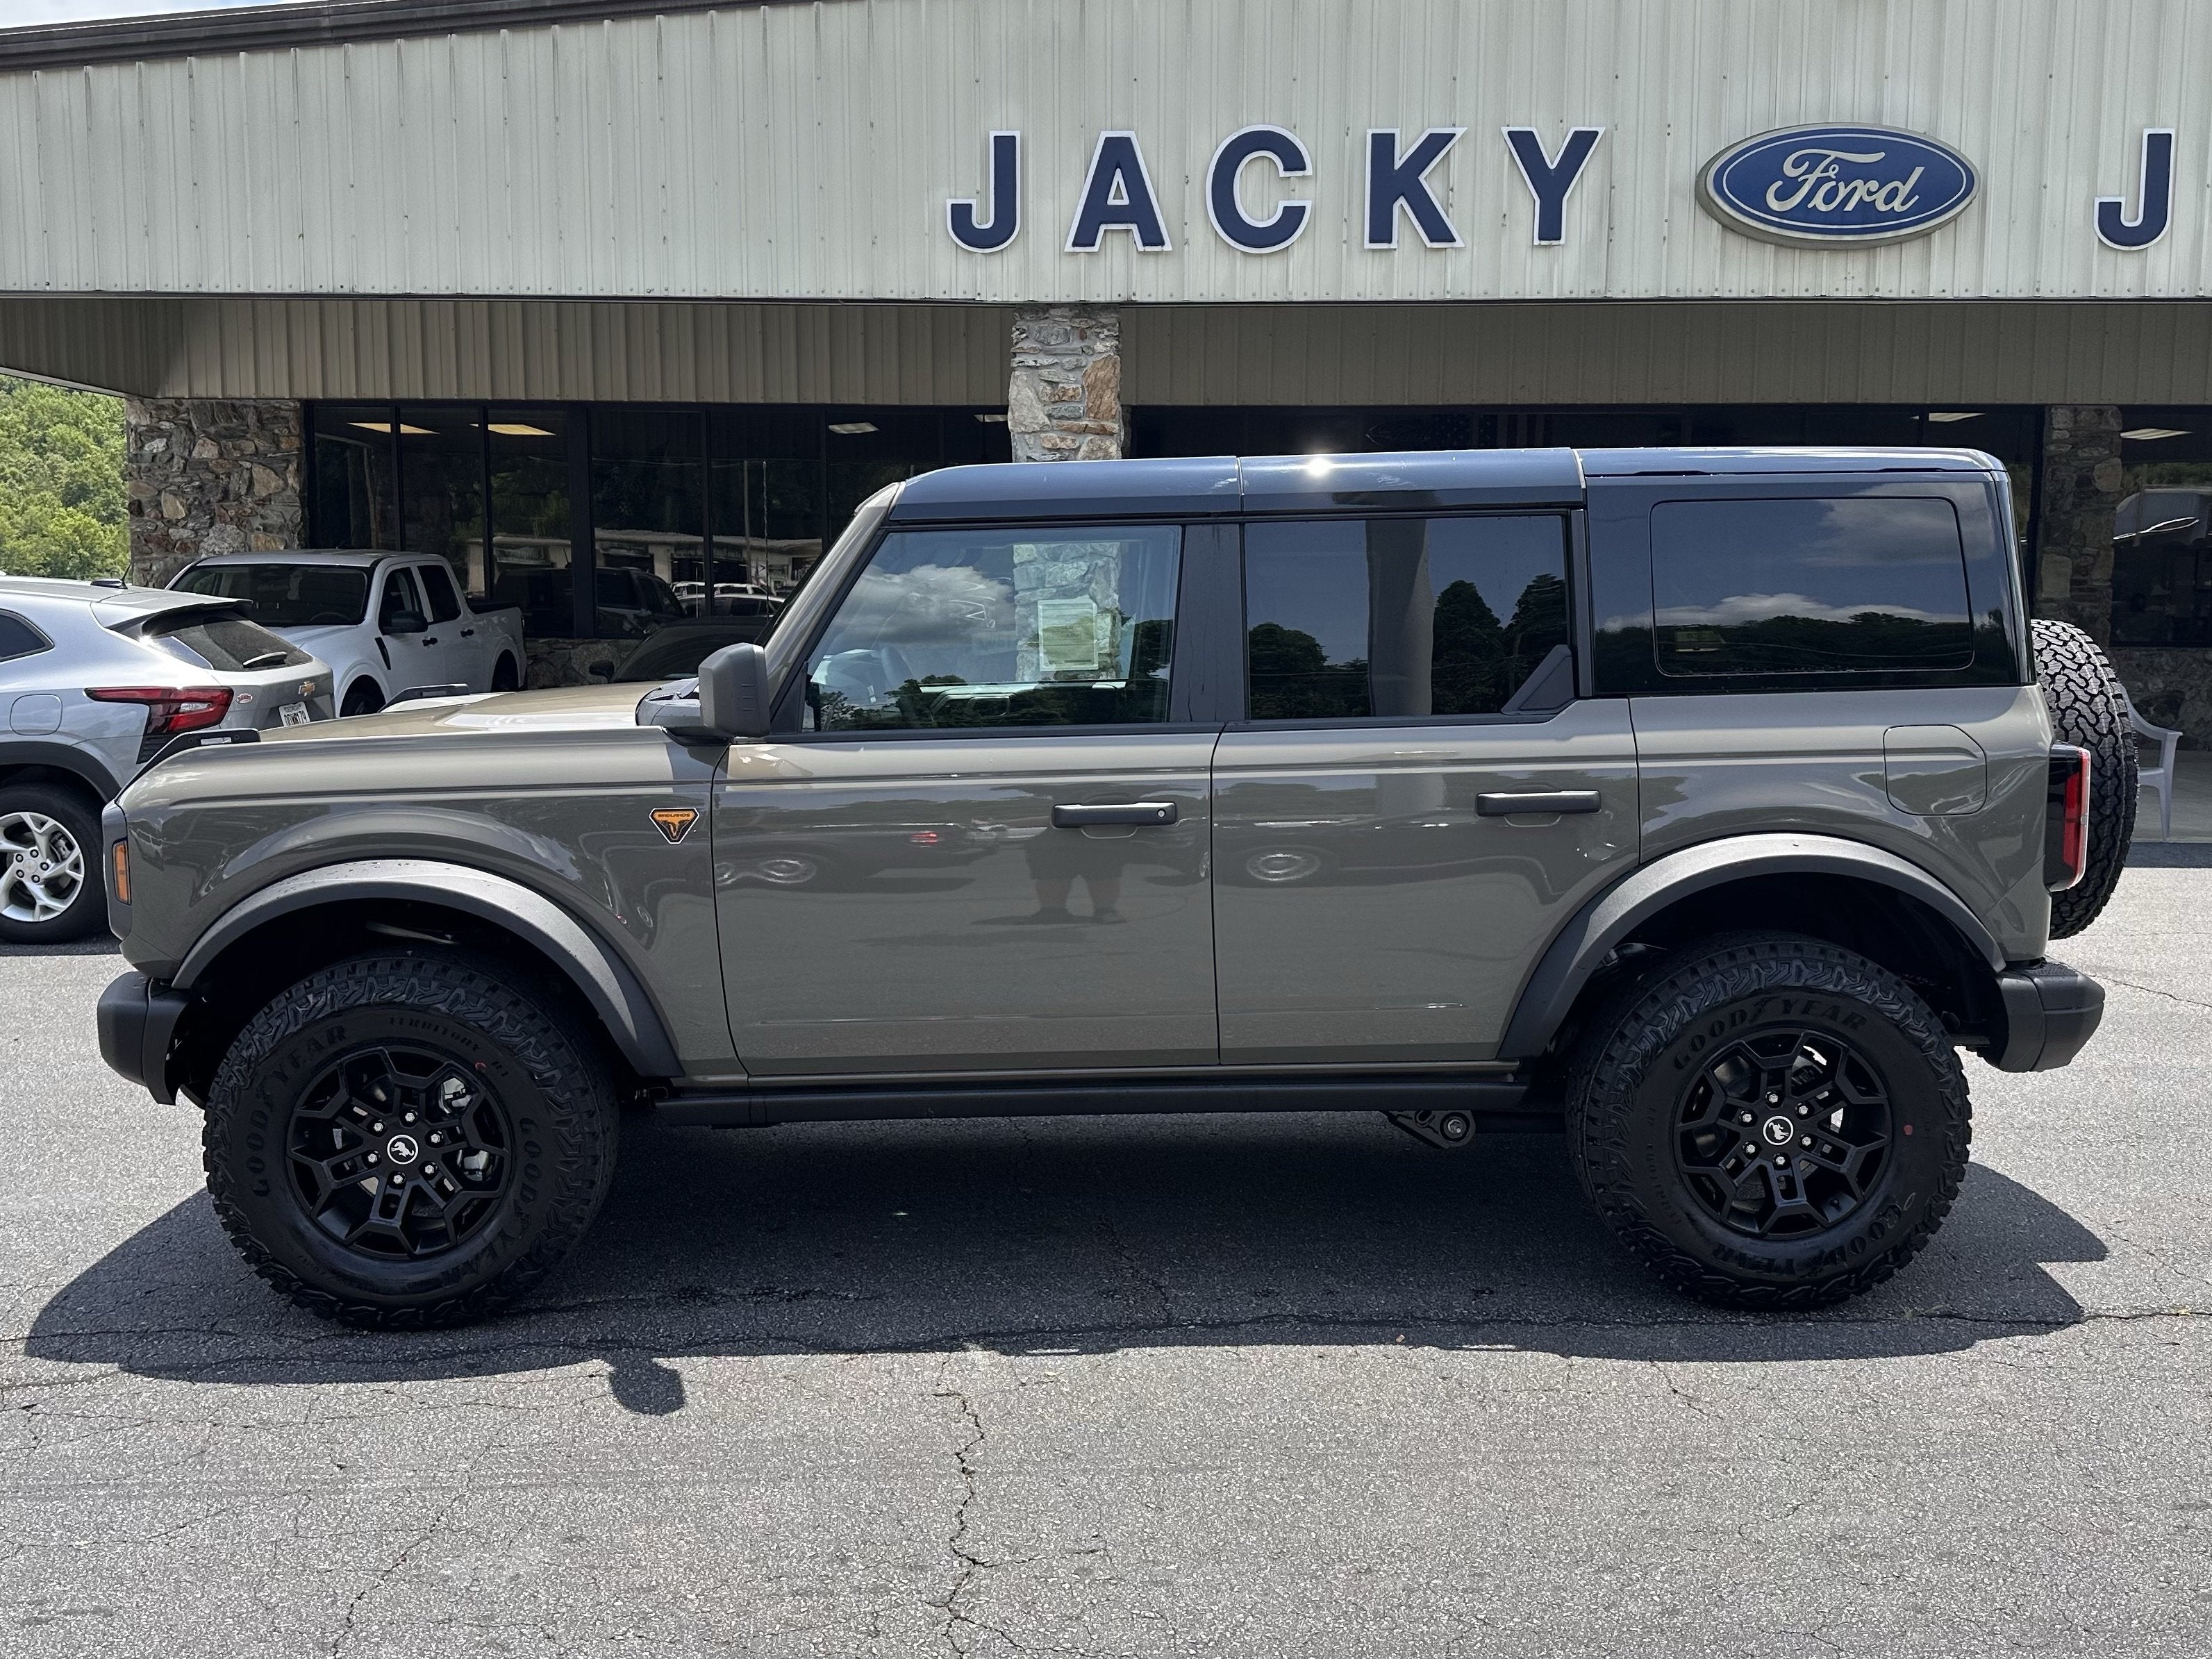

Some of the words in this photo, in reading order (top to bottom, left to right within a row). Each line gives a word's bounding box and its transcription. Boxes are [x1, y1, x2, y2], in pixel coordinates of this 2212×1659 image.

[947, 125, 1606, 255] JACKY
[1765, 149, 1924, 212] Ford
[2093, 128, 2175, 251] J
